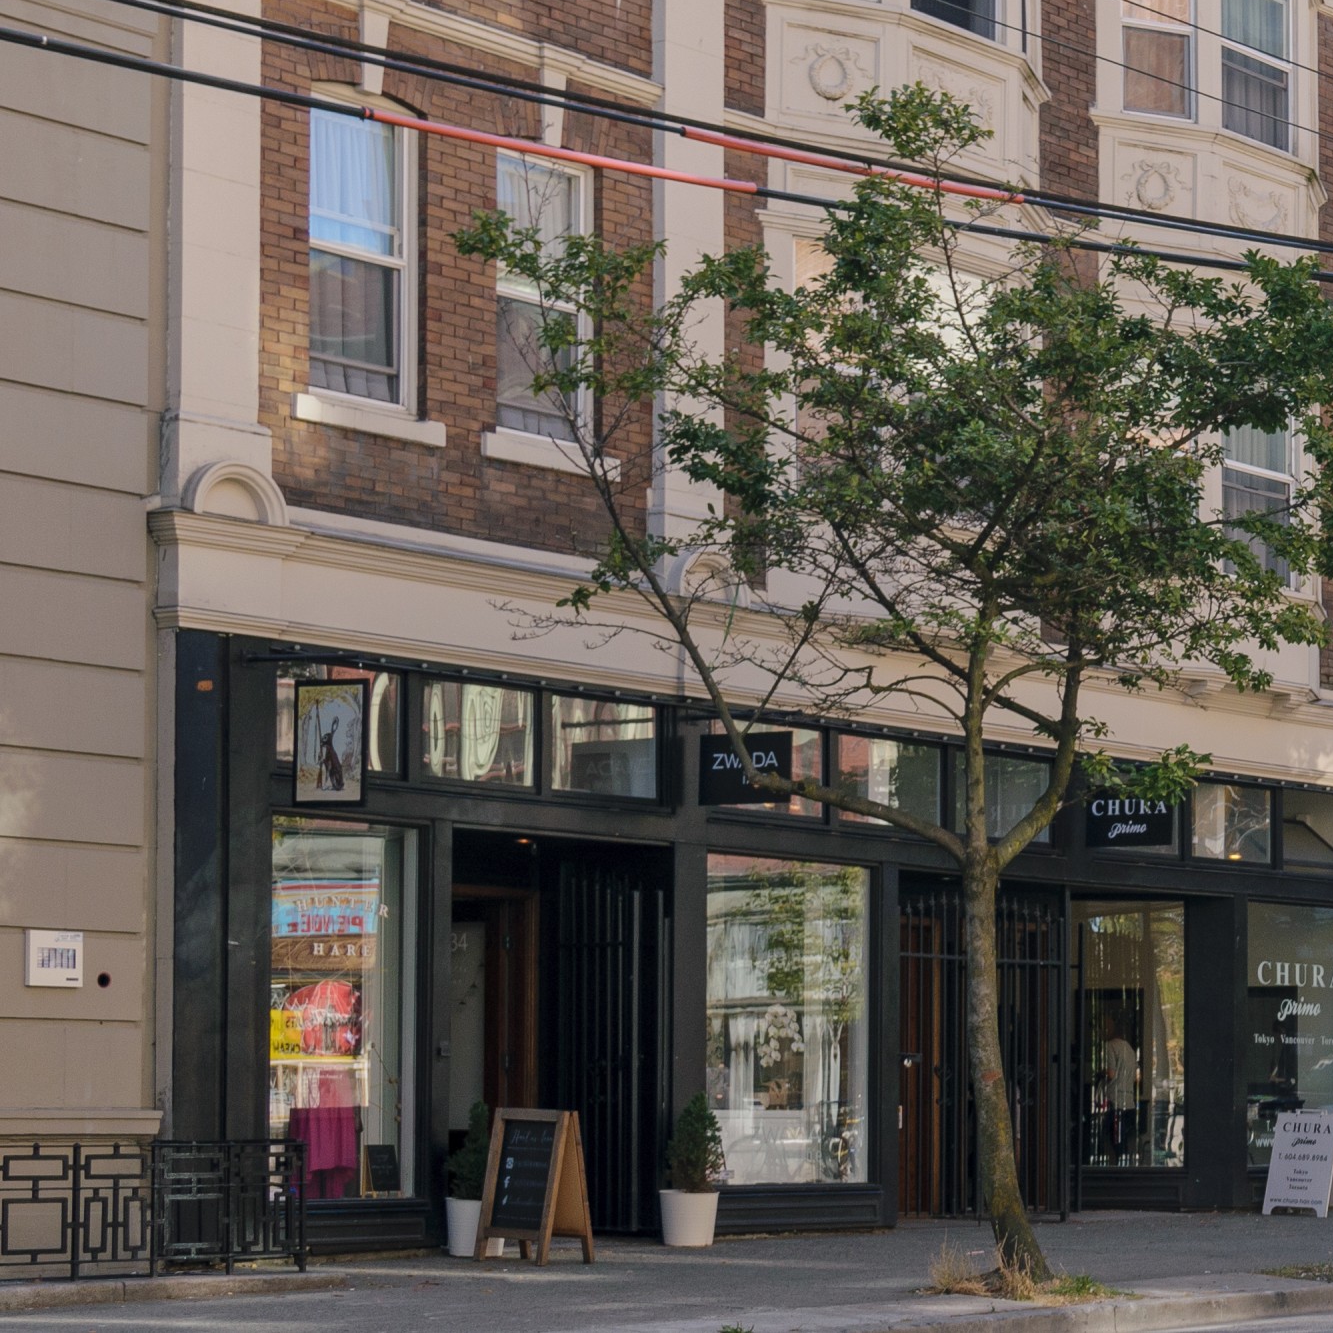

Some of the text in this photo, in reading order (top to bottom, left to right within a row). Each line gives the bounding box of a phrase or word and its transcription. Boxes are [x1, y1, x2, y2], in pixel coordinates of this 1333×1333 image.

[713, 751, 778, 770] ZWDA
[1108, 820, 1148, 839] primo
[297, 896, 389, 918] HUNTER
[313, 942, 371, 957] HARE
[1277, 996, 1321, 1022] primo
[1253, 1033, 1275, 1046] Tokyo
[1280, 1034, 1315, 1045] Vancouver
[1282, 1122, 1331, 1134] CHURA
[1291, 1136, 1317, 1147] primo
